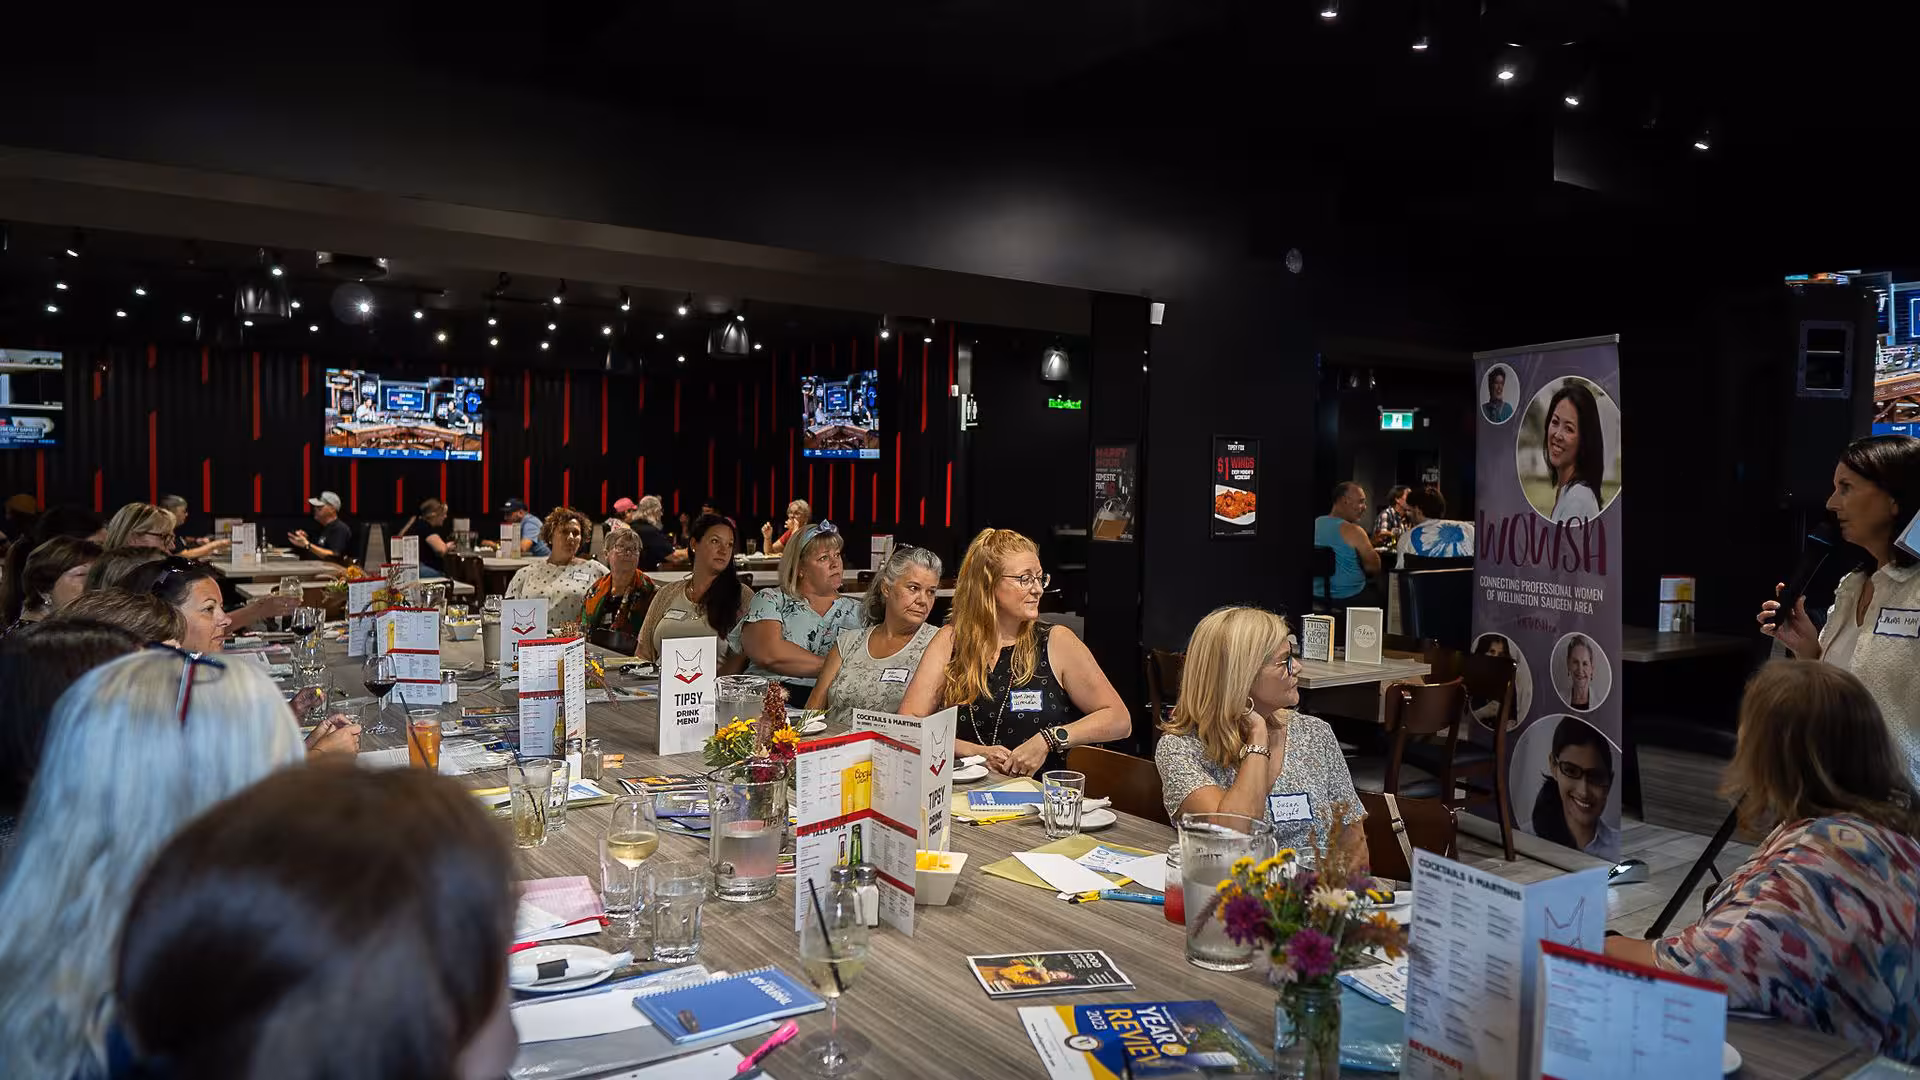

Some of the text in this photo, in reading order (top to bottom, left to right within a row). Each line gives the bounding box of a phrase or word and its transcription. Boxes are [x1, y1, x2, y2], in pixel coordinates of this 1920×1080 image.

[1230, 456, 1255, 469] WINGS
[1095, 473, 1117, 482] DOMESTIC
[1479, 575, 1604, 604] CONNECTING PROFESSIONAL WOMEN
[1487, 590, 1594, 615] OF WELLINGTON SAUGEEN AREA
[1307, 622, 1328, 630] THINK
[1305, 630, 1328, 639] GROW
[1307, 637, 1326, 645] RICH
[674, 691, 703, 706] TIPSY
[676, 709, 700, 718] DRINK
[856, 713, 887, 724] COCKTAILS
[893, 719, 922, 729] MARTINIS
[676, 717, 699, 726] MENU
[929, 785, 946, 810] TIPSY
[1276, 800, 1300, 808] Susan
[929, 810, 943, 826] DRINK
[1276, 808, 1300, 819] Wright
[929, 821, 942, 837] MENU
[1418, 858, 1467, 882] COCKTAILS
[1468, 874, 1474, 885] &
[1475, 878, 1522, 901] MARTINIS
[1083, 953, 1102, 968] FOOD
[1085, 1009, 1108, 1031] 2023
[1135, 1005, 1178, 1044] YEAR
[1408, 1038, 1463, 1071] BEVERAGES
